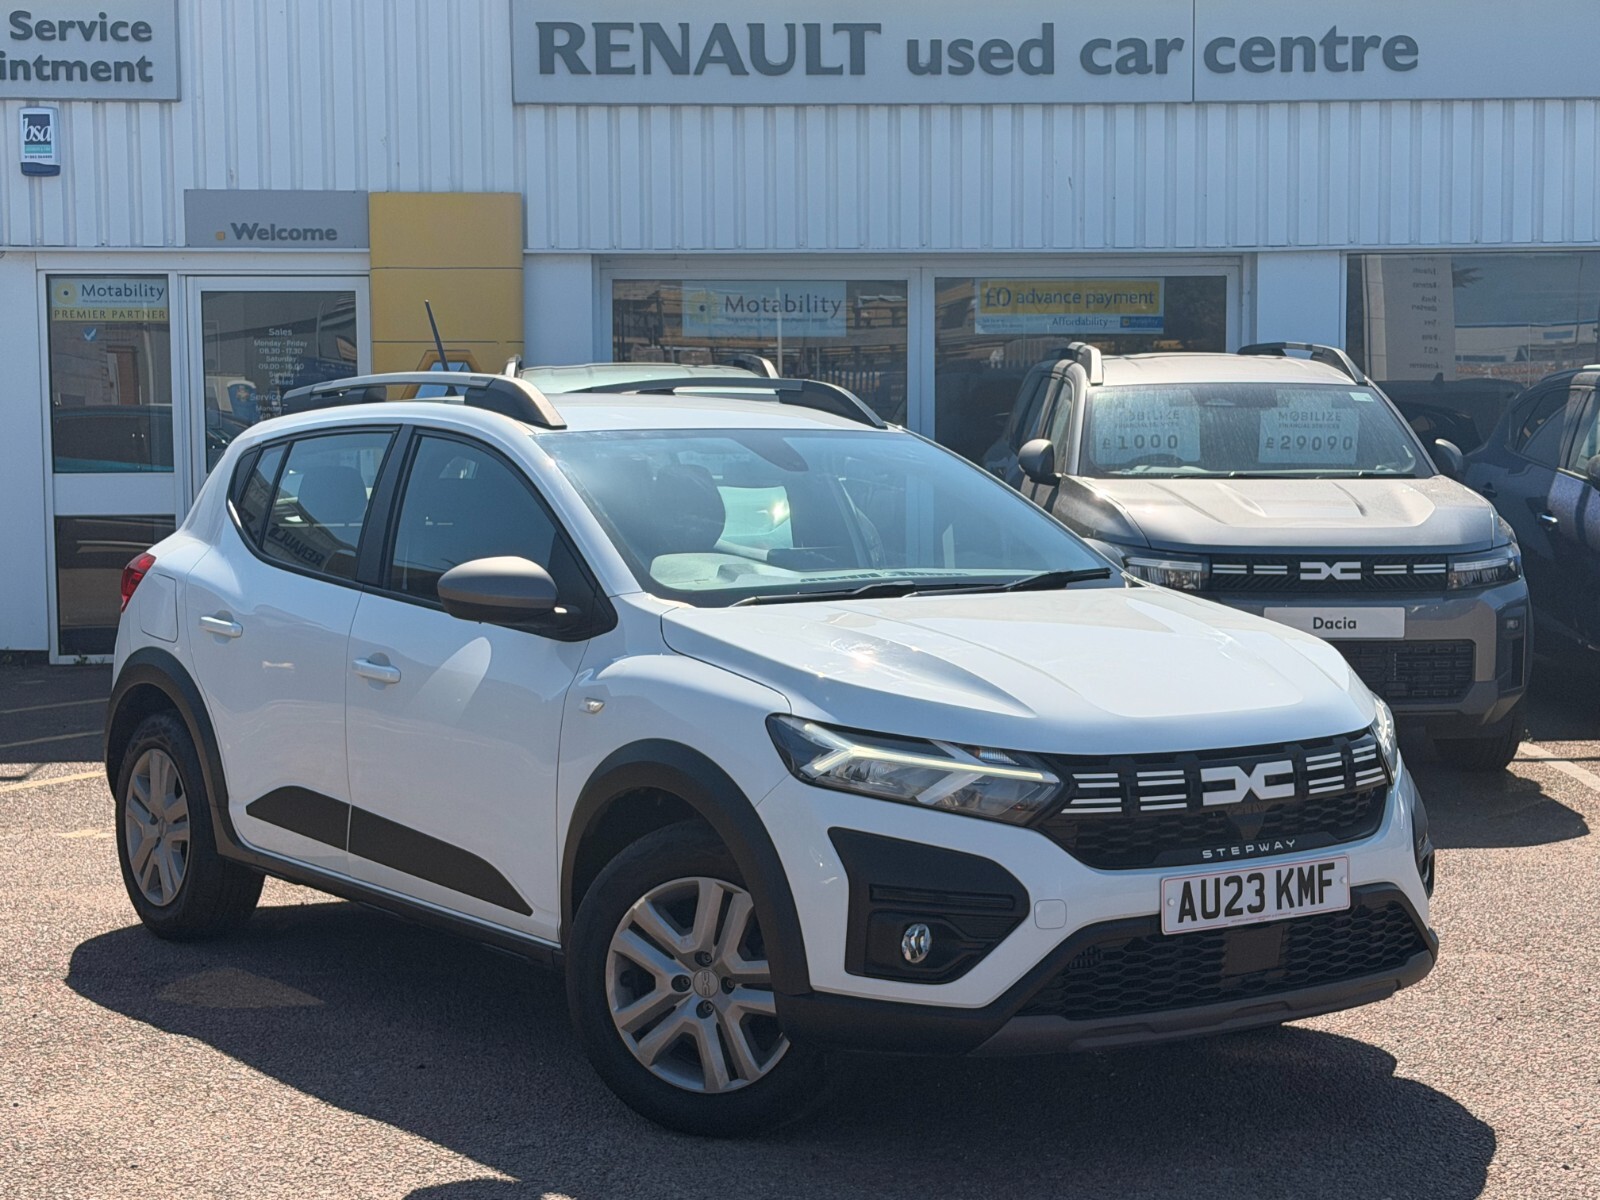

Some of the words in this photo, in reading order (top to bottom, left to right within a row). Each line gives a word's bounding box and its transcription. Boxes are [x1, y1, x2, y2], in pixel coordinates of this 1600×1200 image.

[9, 10, 152, 42] Service
[535, 22, 882, 76] RENAULT
[906, 22, 1055, 76] used
[1079, 36, 1185, 74] car
[1203, 25, 1419, 73] centre
[0, 51, 153, 83] intment
[23, 117, 51, 142] bsa
[230, 222, 338, 241] Welcome
[81, 283, 165, 300] Motability
[985, 286, 1012, 307] £0
[1017, 288, 1081, 304] advance
[1085, 290, 1154, 308] payment
[54, 309, 107, 319] PREMIER
[111, 309, 166, 319] PARTNER
[725, 293, 842, 319] Motability
[1052, 316, 1109, 328] Affordability
[268, 328, 293, 336] Sales
[254, 340, 282, 348] Monday
[286, 340, 308, 348] Friday
[265, 355, 298, 363] Saturday
[249, 392, 281, 401] Service
[1312, 616, 1357, 630] Dacia
[1202, 839, 1296, 859] STEPWAY
[1177, 872, 1266, 923] AU23
[1275, 862, 1335, 910] KMF
